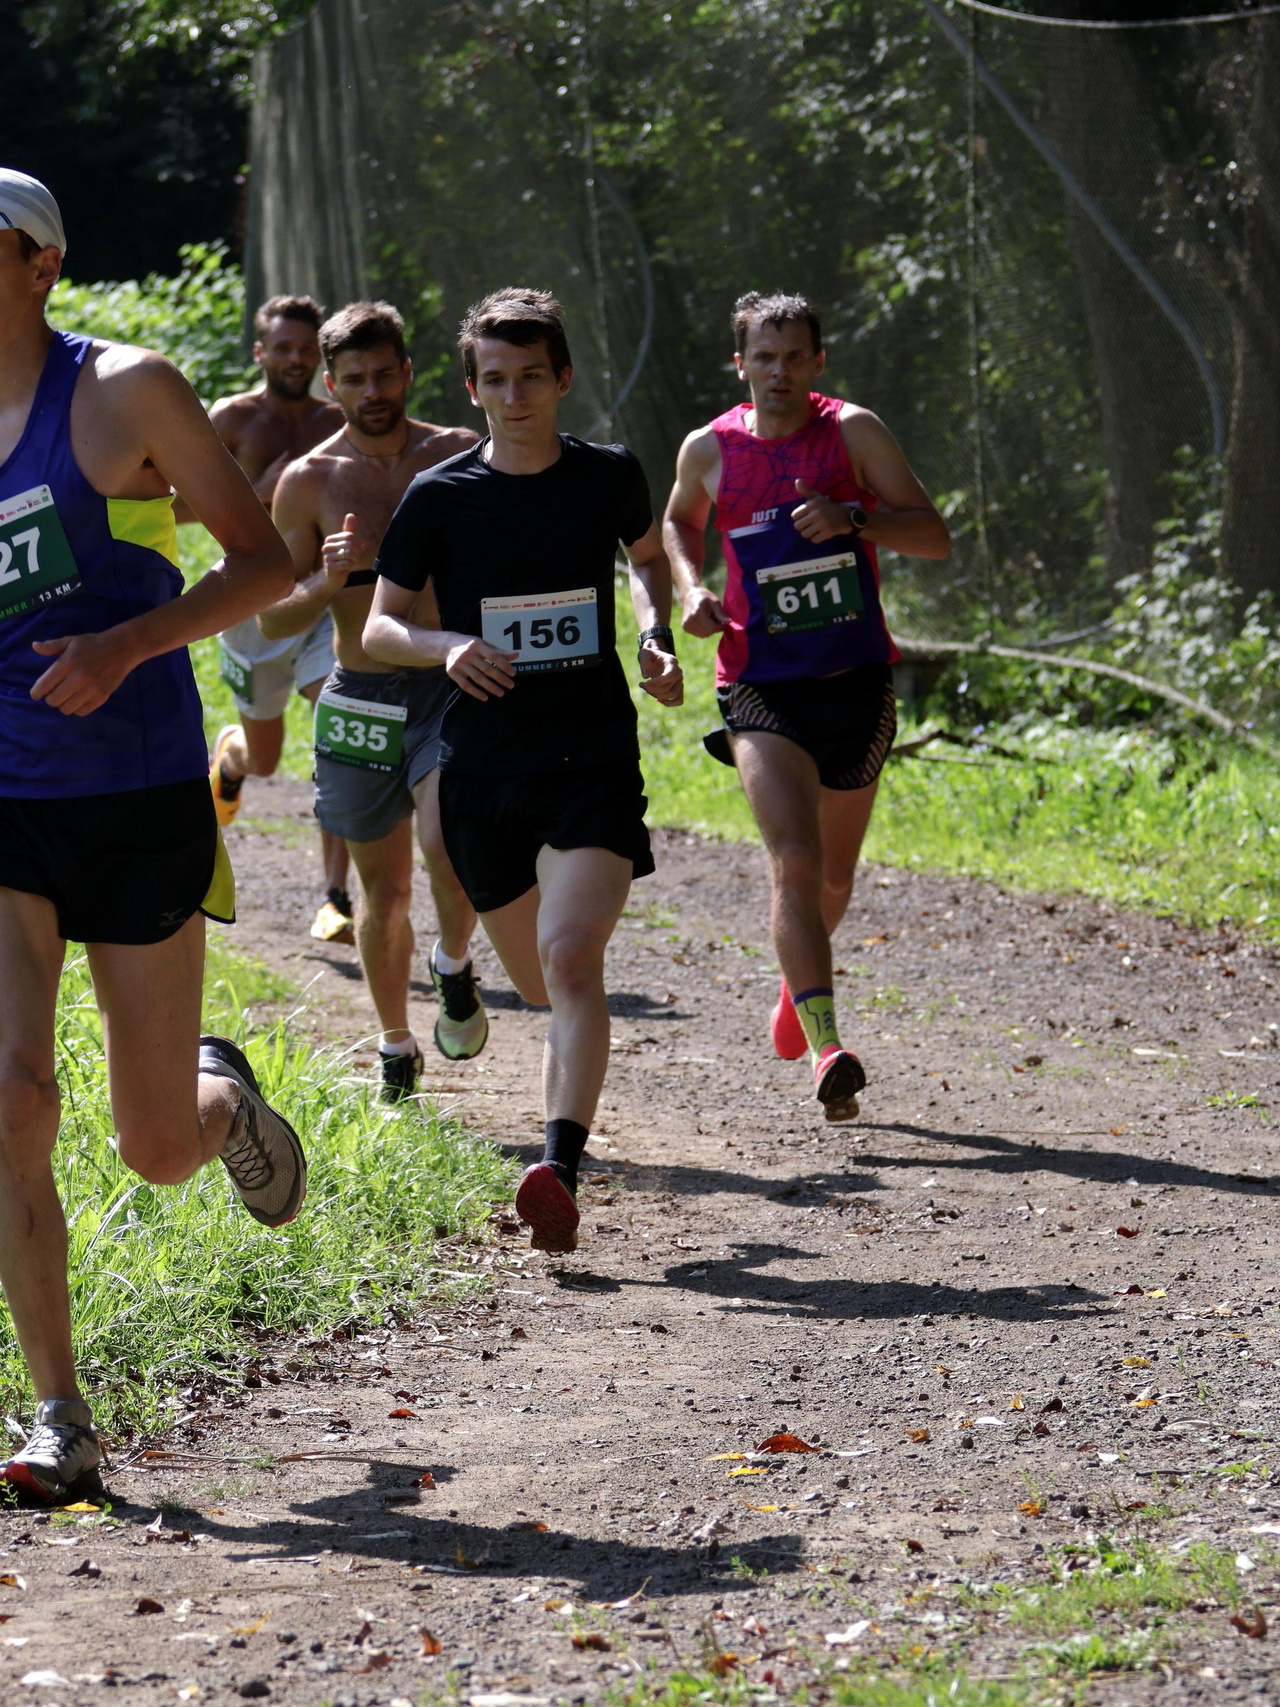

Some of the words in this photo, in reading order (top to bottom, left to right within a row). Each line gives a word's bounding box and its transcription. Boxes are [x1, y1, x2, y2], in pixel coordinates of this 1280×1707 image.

[751, 508, 778, 524] JUST
[39, 591, 52, 602] 13
[55, 583, 71, 596] KM
[777, 577, 842, 614] 611
[503, 615, 580, 650] 156
[513, 663, 552, 672] SUMMER
[328, 715, 388, 752] 335
